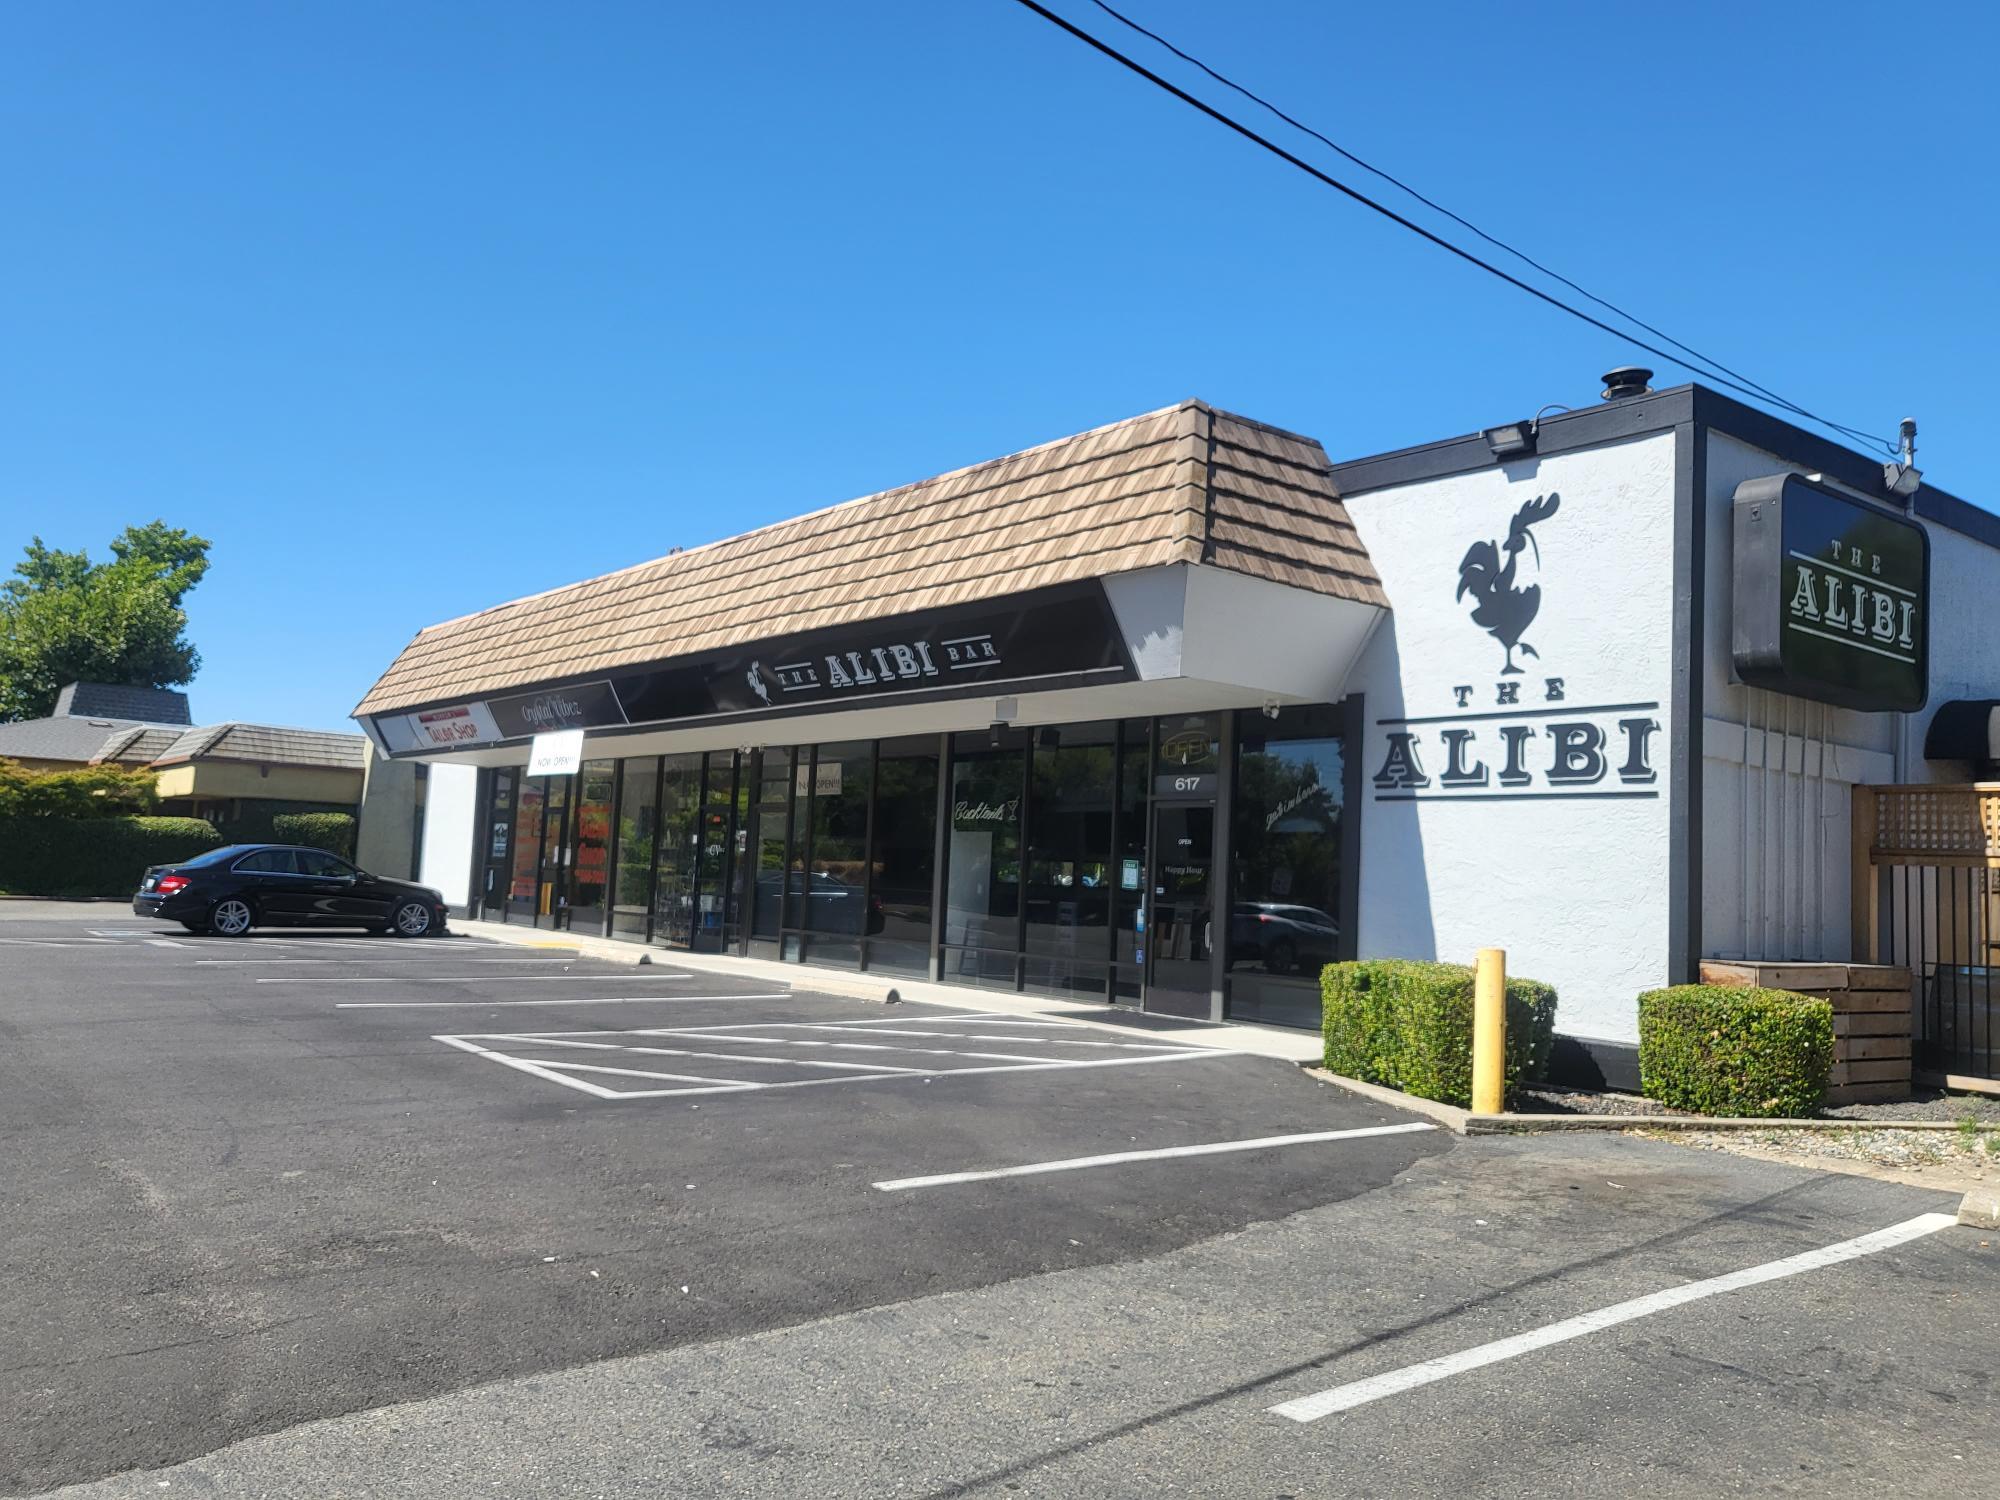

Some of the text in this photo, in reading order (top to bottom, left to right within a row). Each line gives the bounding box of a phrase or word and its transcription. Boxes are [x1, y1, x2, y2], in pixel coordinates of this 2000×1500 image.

[1832, 539, 1881, 574] THE
[1789, 565, 1916, 650] ALIBI
[777, 641, 997, 688] THE ALIBI BAR
[1453, 677, 1565, 707] THE
[453, 722, 478, 739] SHOP
[1372, 717, 1661, 789] ALIBI
[1174, 777, 1200, 791] 617
[955, 800, 1006, 820] Cocktails
[1165, 865, 1203, 875] Happy Hour
